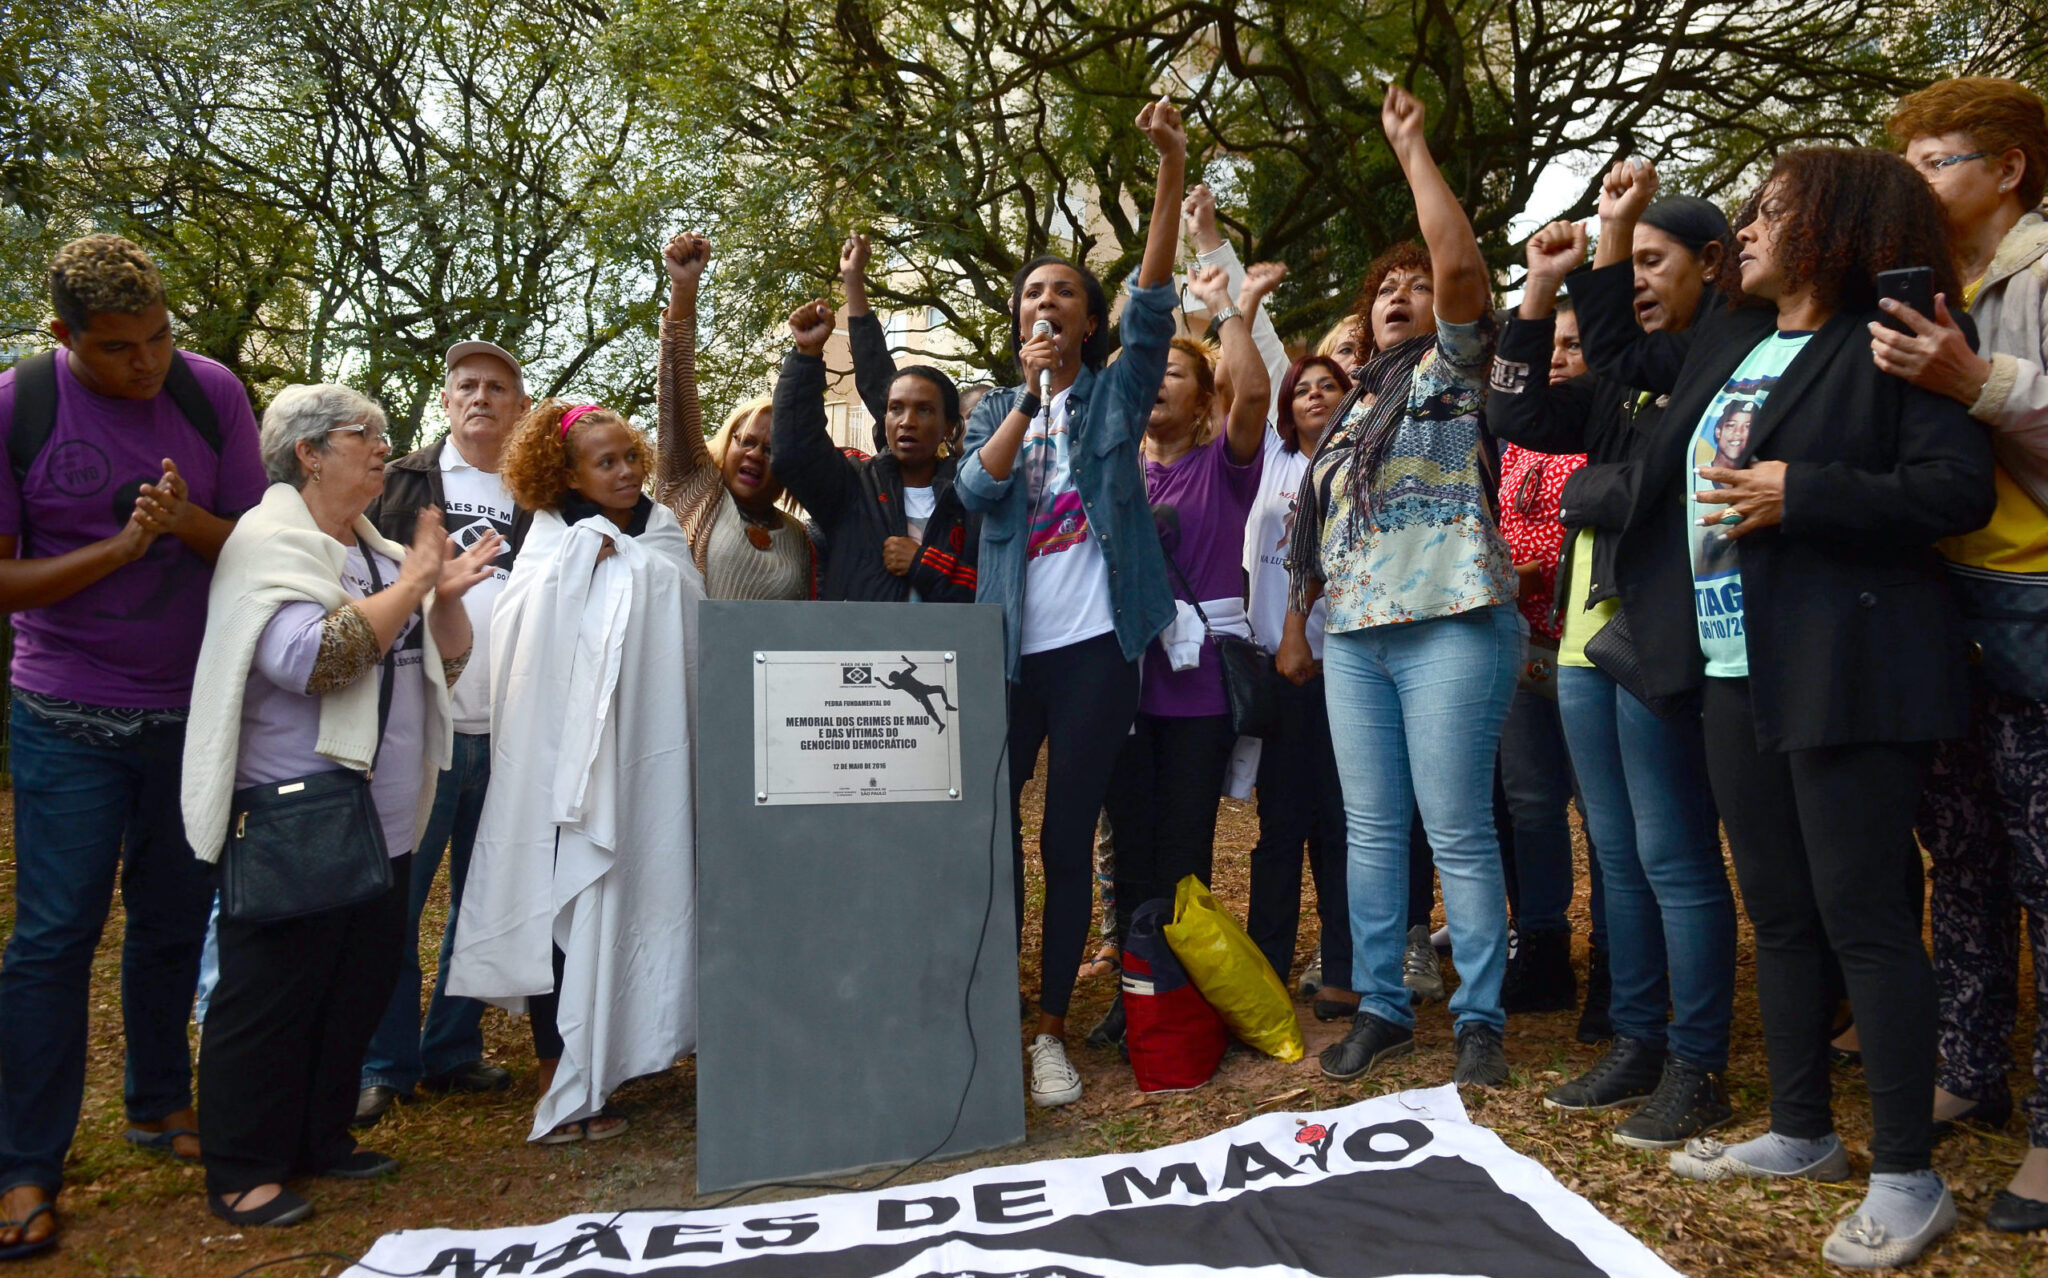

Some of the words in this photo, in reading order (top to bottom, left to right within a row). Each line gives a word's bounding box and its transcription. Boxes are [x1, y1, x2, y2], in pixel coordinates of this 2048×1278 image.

[444, 500, 472, 512] ÃES
[477, 504, 496, 517] DE
[1695, 582, 1744, 617] TIAG
[786, 716, 834, 727] MEMORIAL
[836, 716, 855, 726] DOS
[856, 716, 891, 726] CRIMES
[893, 716, 905, 726] DE
[906, 715, 930, 725] MAIO
[818, 728, 824, 738] E
[825, 728, 844, 738] DAS
[845, 726, 884, 738] VÍTIMAS
[885, 727, 899, 737] DO
[800, 738, 850, 750] GENOCÍDIO
[852, 737, 917, 749] DEMOCRÁTICO
[421, 1213, 820, 1278] MÃES
[876, 1179, 1054, 1232] DE
